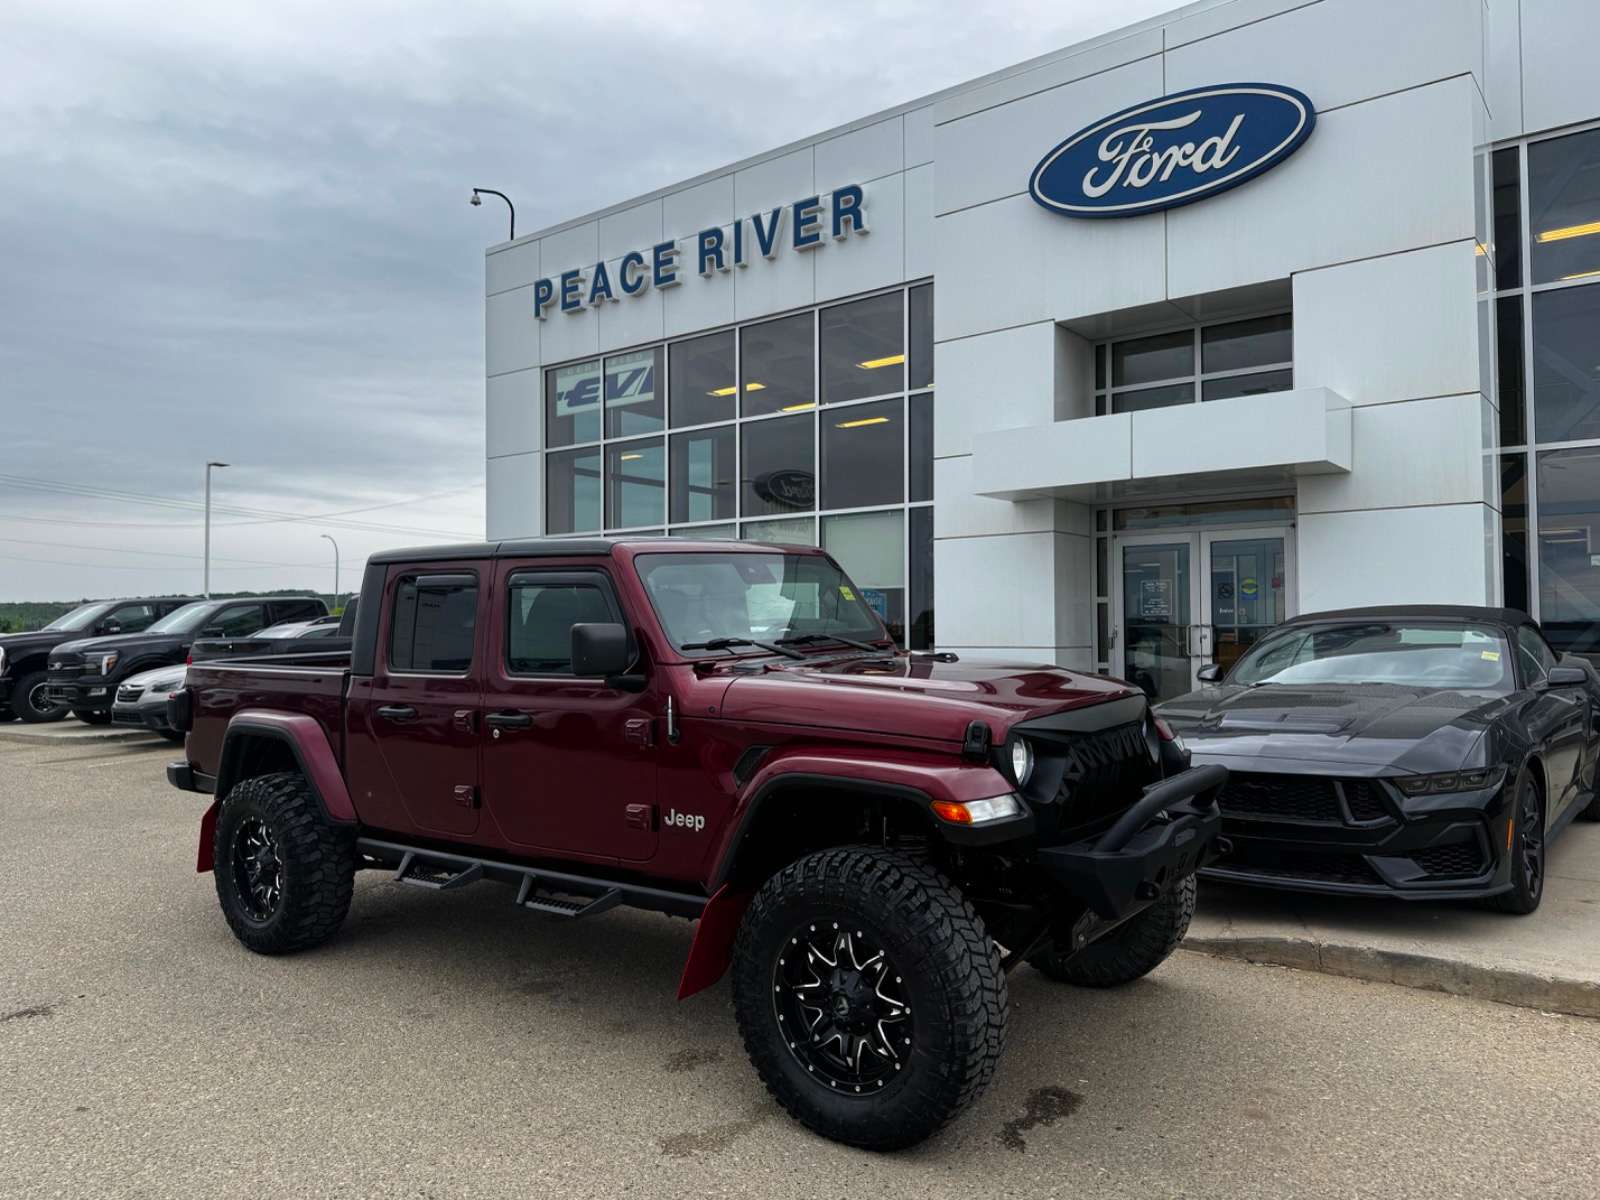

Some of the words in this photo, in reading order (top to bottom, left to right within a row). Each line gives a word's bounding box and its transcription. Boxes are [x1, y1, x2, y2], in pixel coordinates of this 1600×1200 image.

[1082, 110, 1245, 198] Ford
[534, 240, 679, 318] PEACE
[698, 184, 867, 277] RIVER
[664, 808, 705, 832] Jeep
